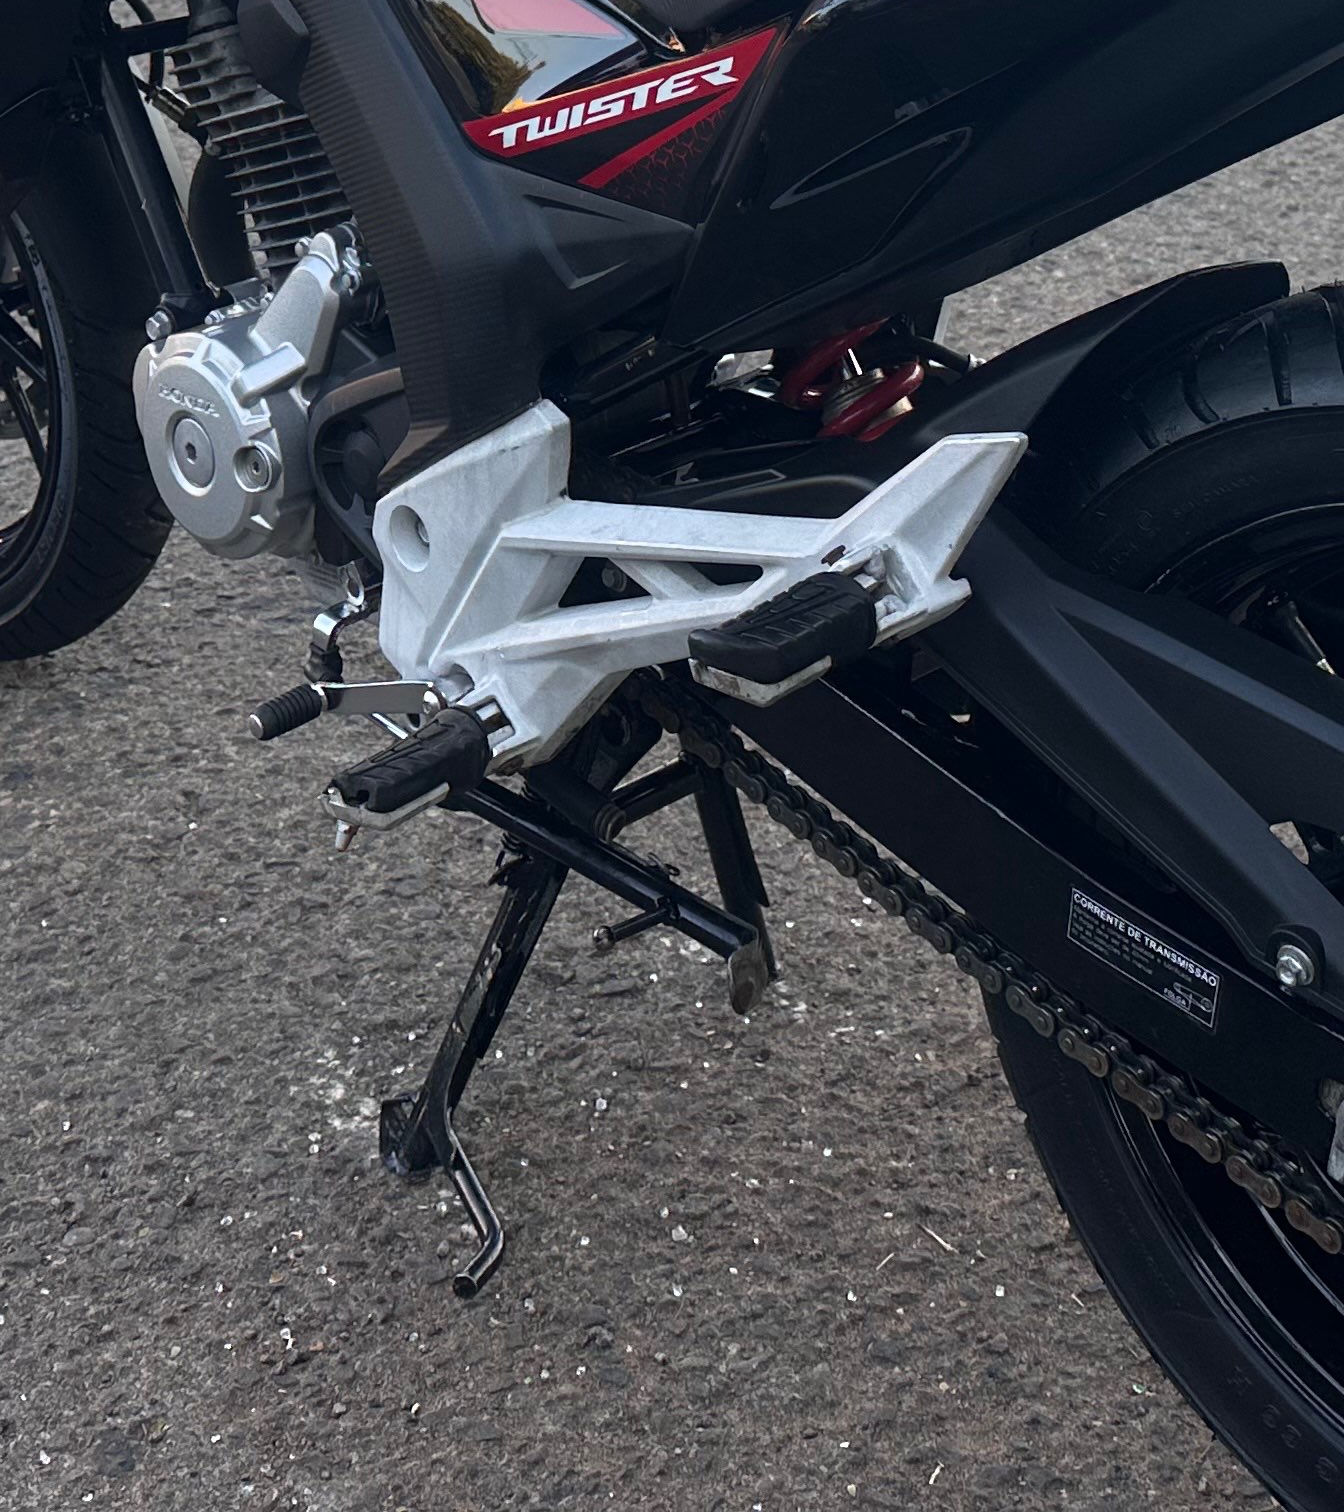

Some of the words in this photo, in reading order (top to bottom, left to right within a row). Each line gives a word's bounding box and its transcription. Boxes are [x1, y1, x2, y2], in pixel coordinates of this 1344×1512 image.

[488, 56, 739, 149] TWISTER
[1073, 893, 1126, 934] CORRENTE
[1127, 926, 1142, 942] DE
